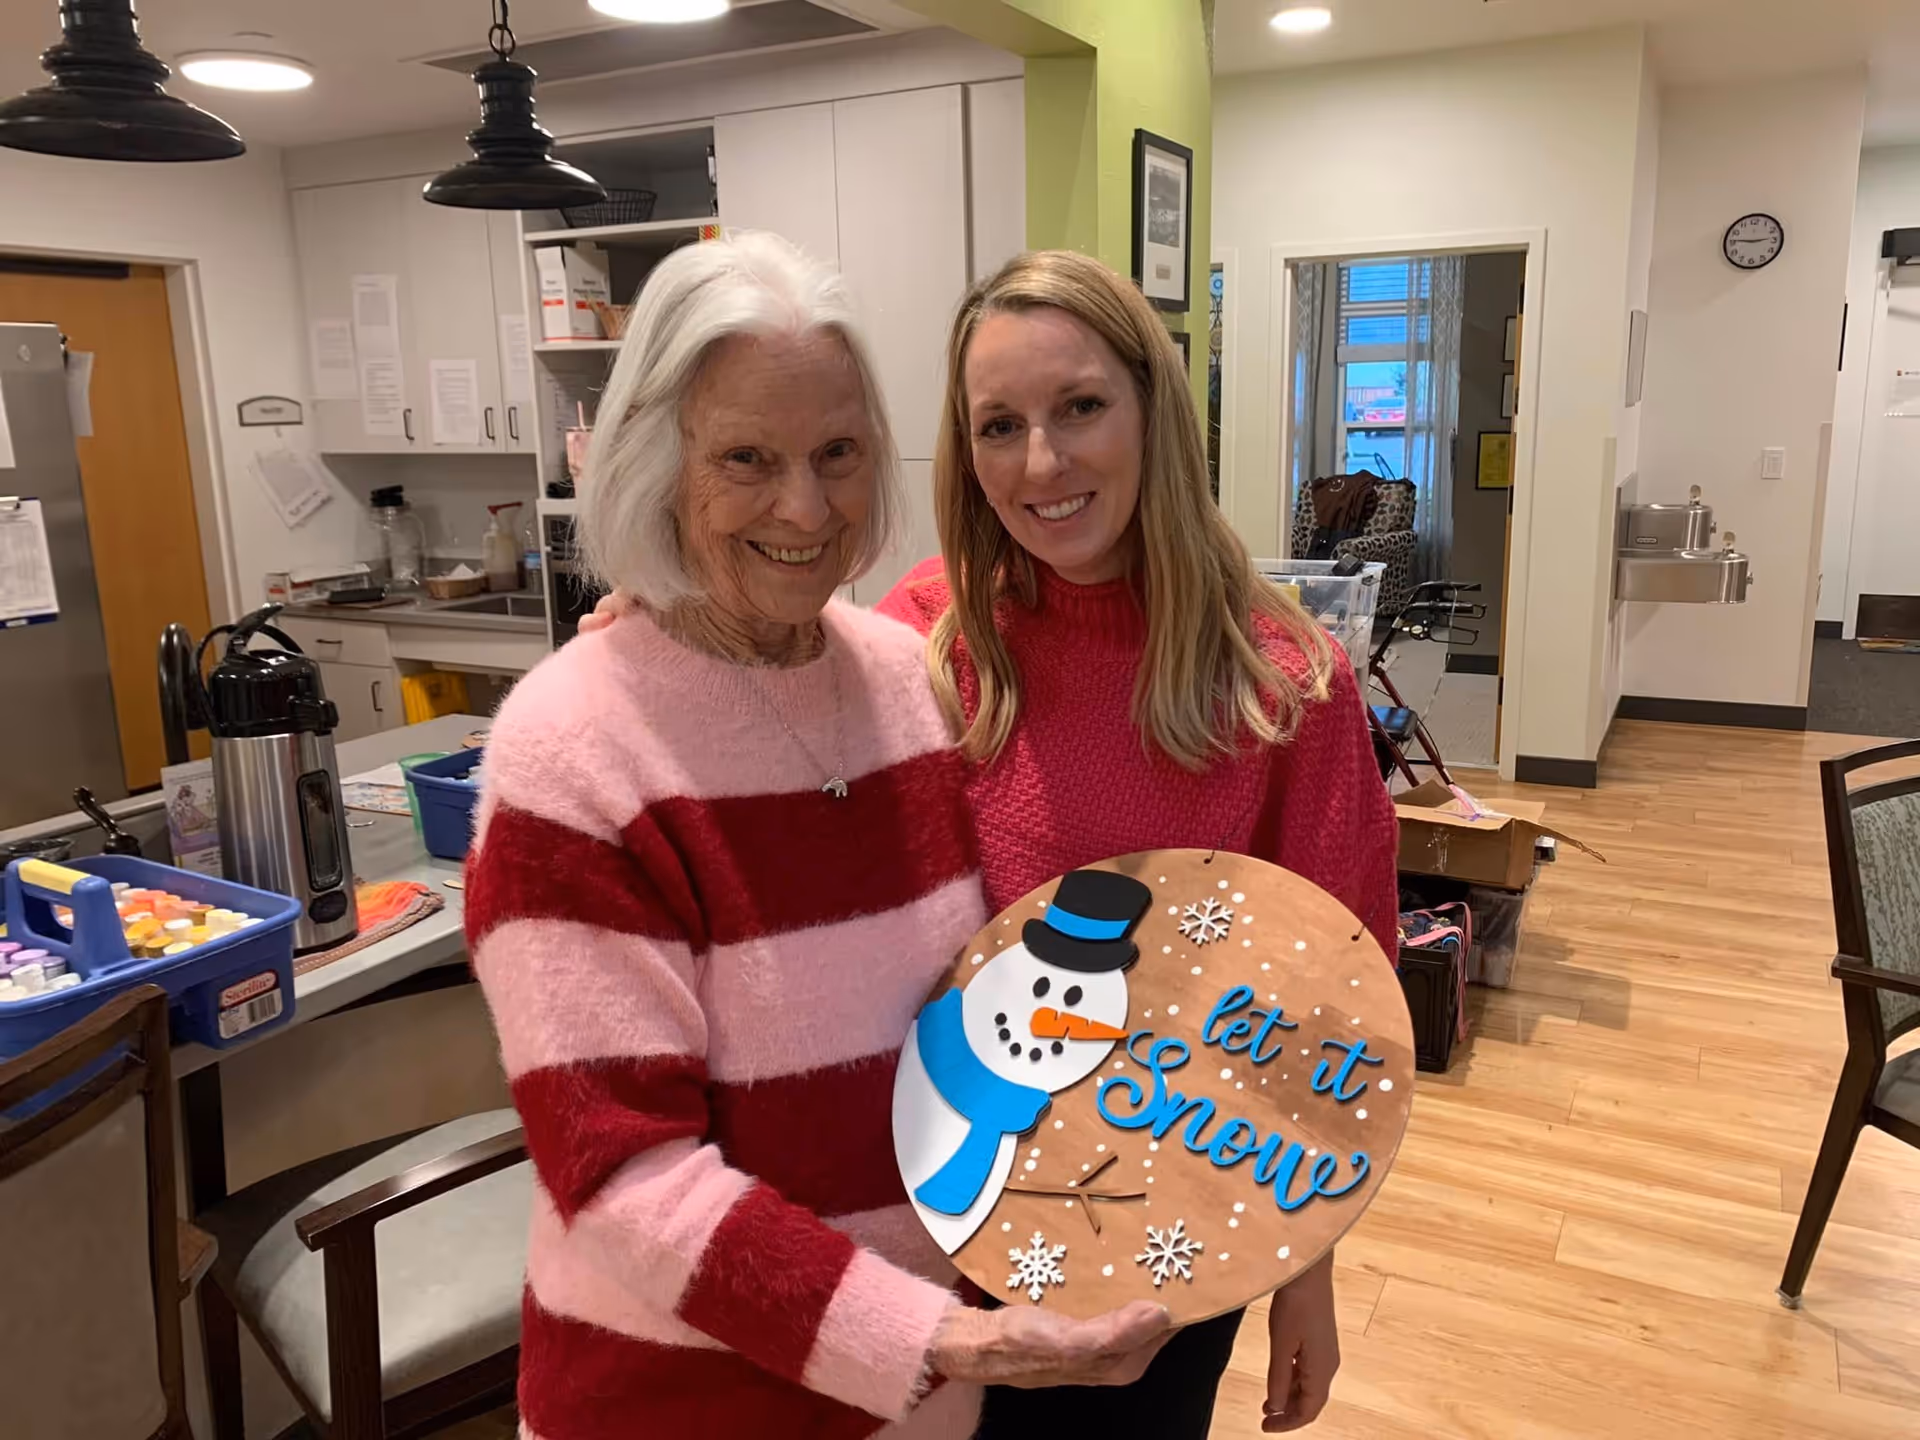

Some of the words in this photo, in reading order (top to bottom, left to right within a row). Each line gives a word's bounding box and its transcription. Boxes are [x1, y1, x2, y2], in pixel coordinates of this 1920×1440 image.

[1750, 218, 1760, 226] 12
[1769, 226, 1777, 234] 2
[1770, 236, 1778, 244] 3
[1747, 257, 1755, 265] 6
[1202, 984, 1298, 1063] let
[1310, 1039, 1384, 1103] it
[1096, 1030, 1370, 1210] Snow
